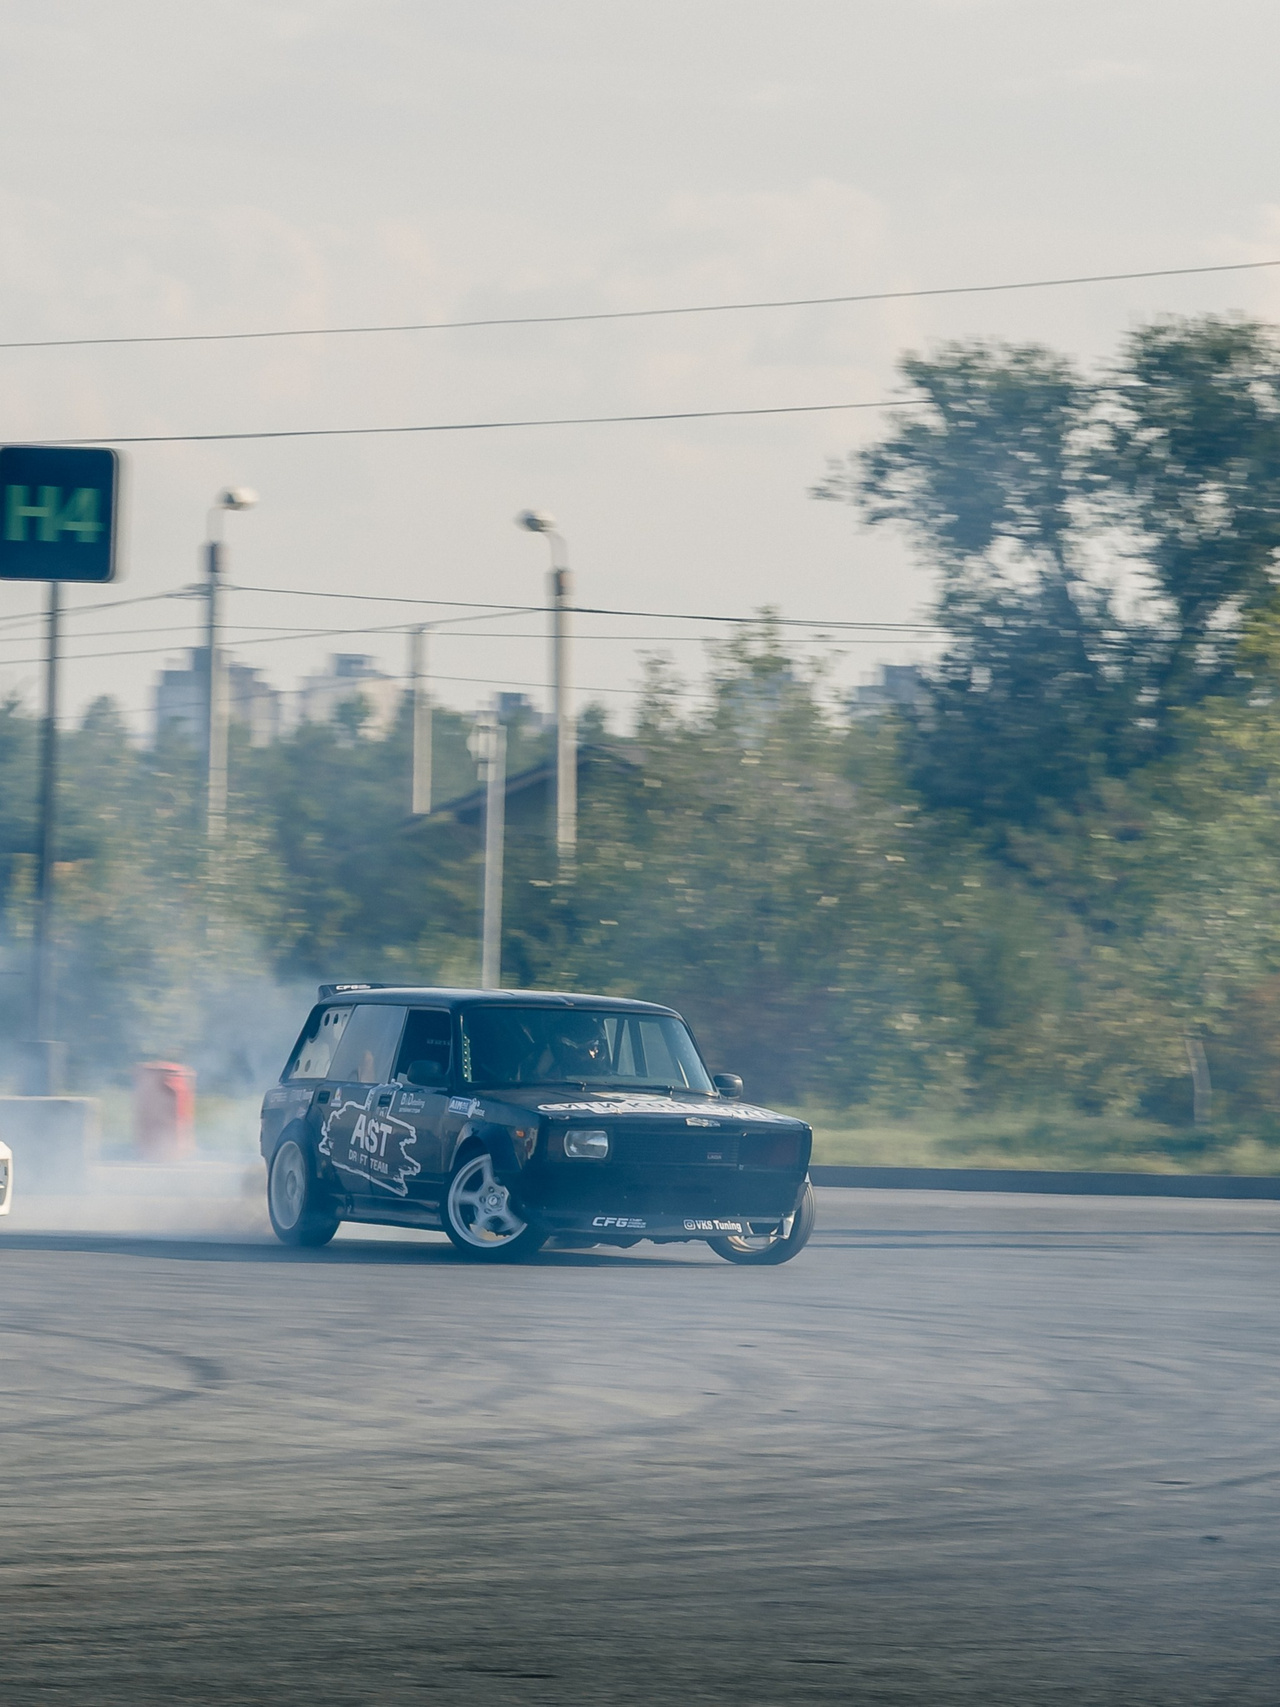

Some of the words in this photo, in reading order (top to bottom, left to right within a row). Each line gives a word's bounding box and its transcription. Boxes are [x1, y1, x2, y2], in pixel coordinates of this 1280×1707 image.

[350, 1113, 393, 1157] AST
[348, 1149, 368, 1166] DRFT
[370, 1157, 389, 1175] TEAM
[592, 1216, 629, 1228] CFG
[695, 1219, 713, 1230] VKS
[713, 1219, 743, 1233] Tuning
